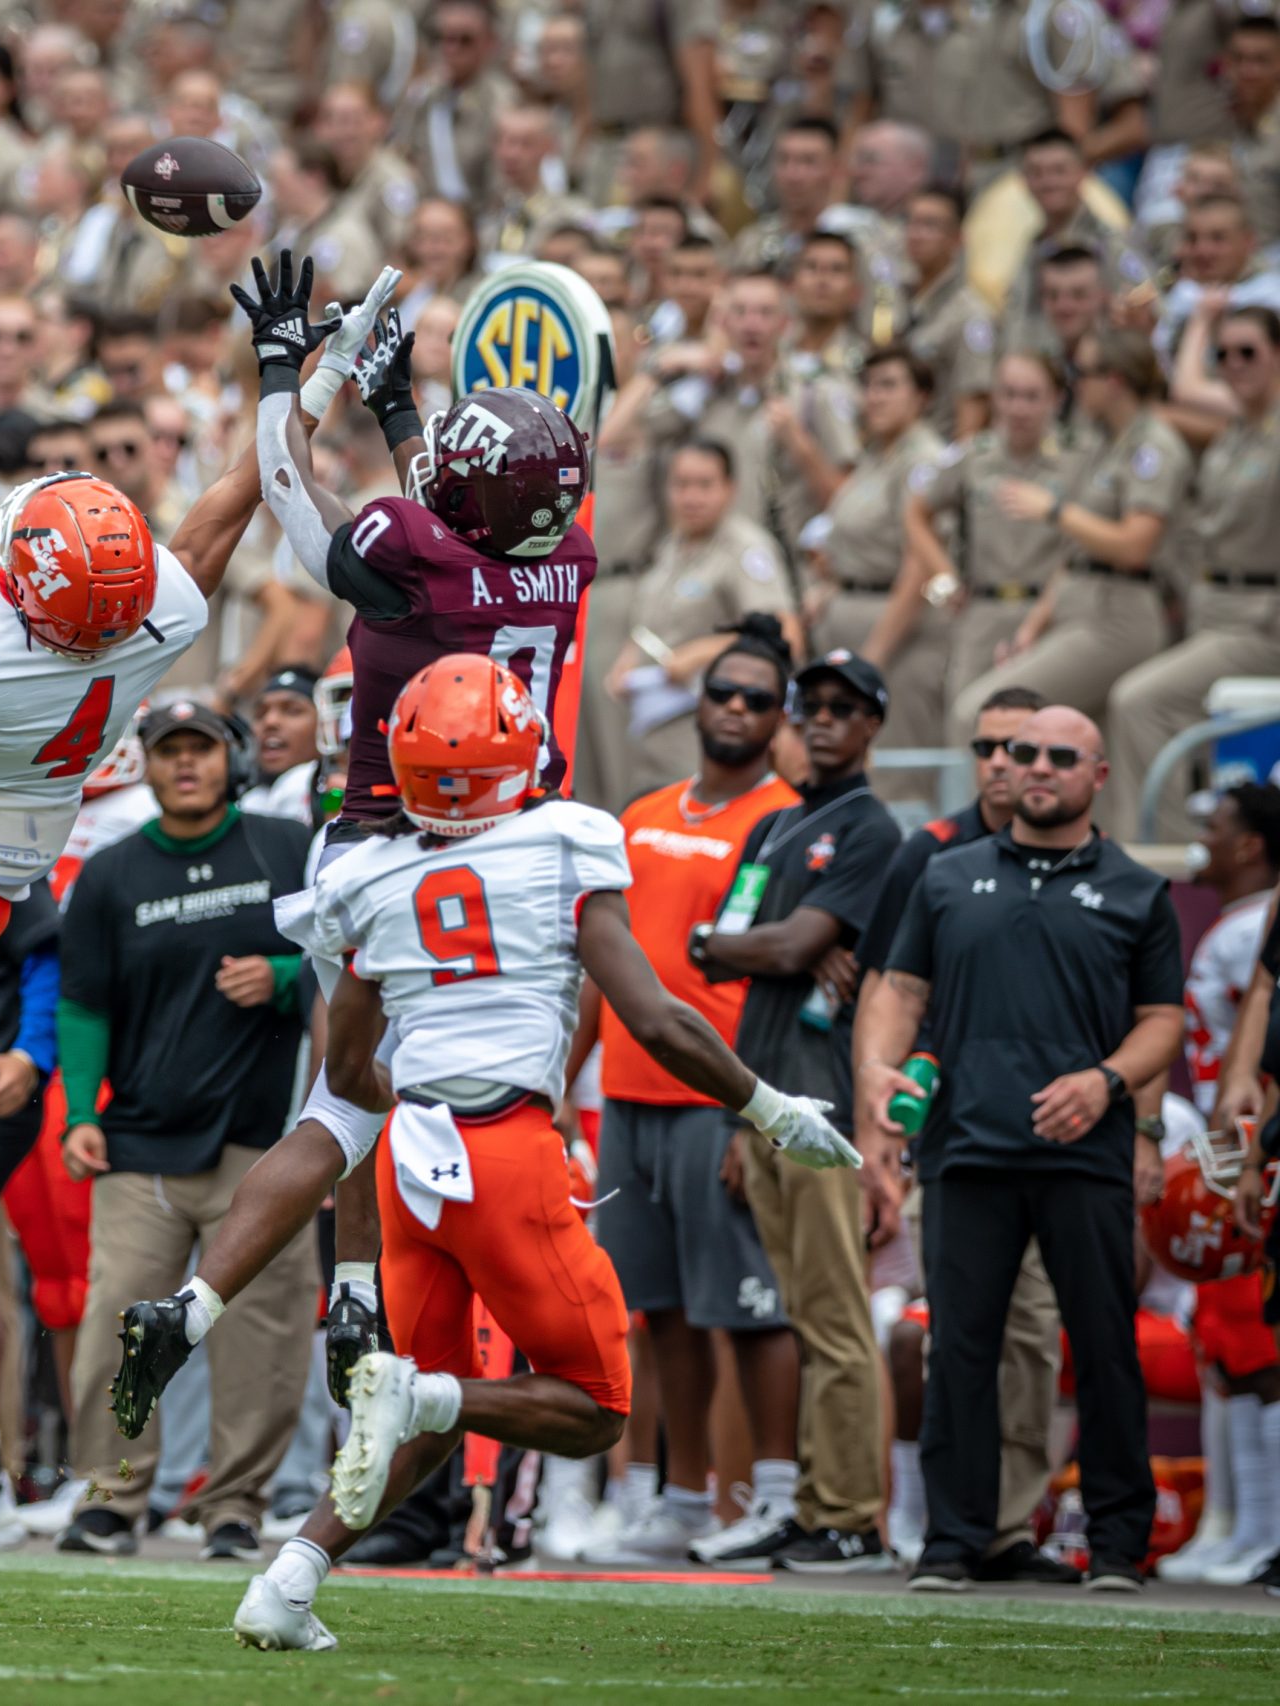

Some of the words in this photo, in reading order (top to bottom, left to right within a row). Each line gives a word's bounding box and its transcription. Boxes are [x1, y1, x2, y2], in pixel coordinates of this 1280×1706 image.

[271, 325, 306, 347] adidas
[472, 296, 572, 410] SEC
[351, 509, 392, 559] 0
[472, 567, 503, 606] A.
[509, 565, 579, 603] SMITH
[30, 674, 116, 779] 4
[135, 896, 181, 927] SAM
[411, 863, 506, 987] 9
